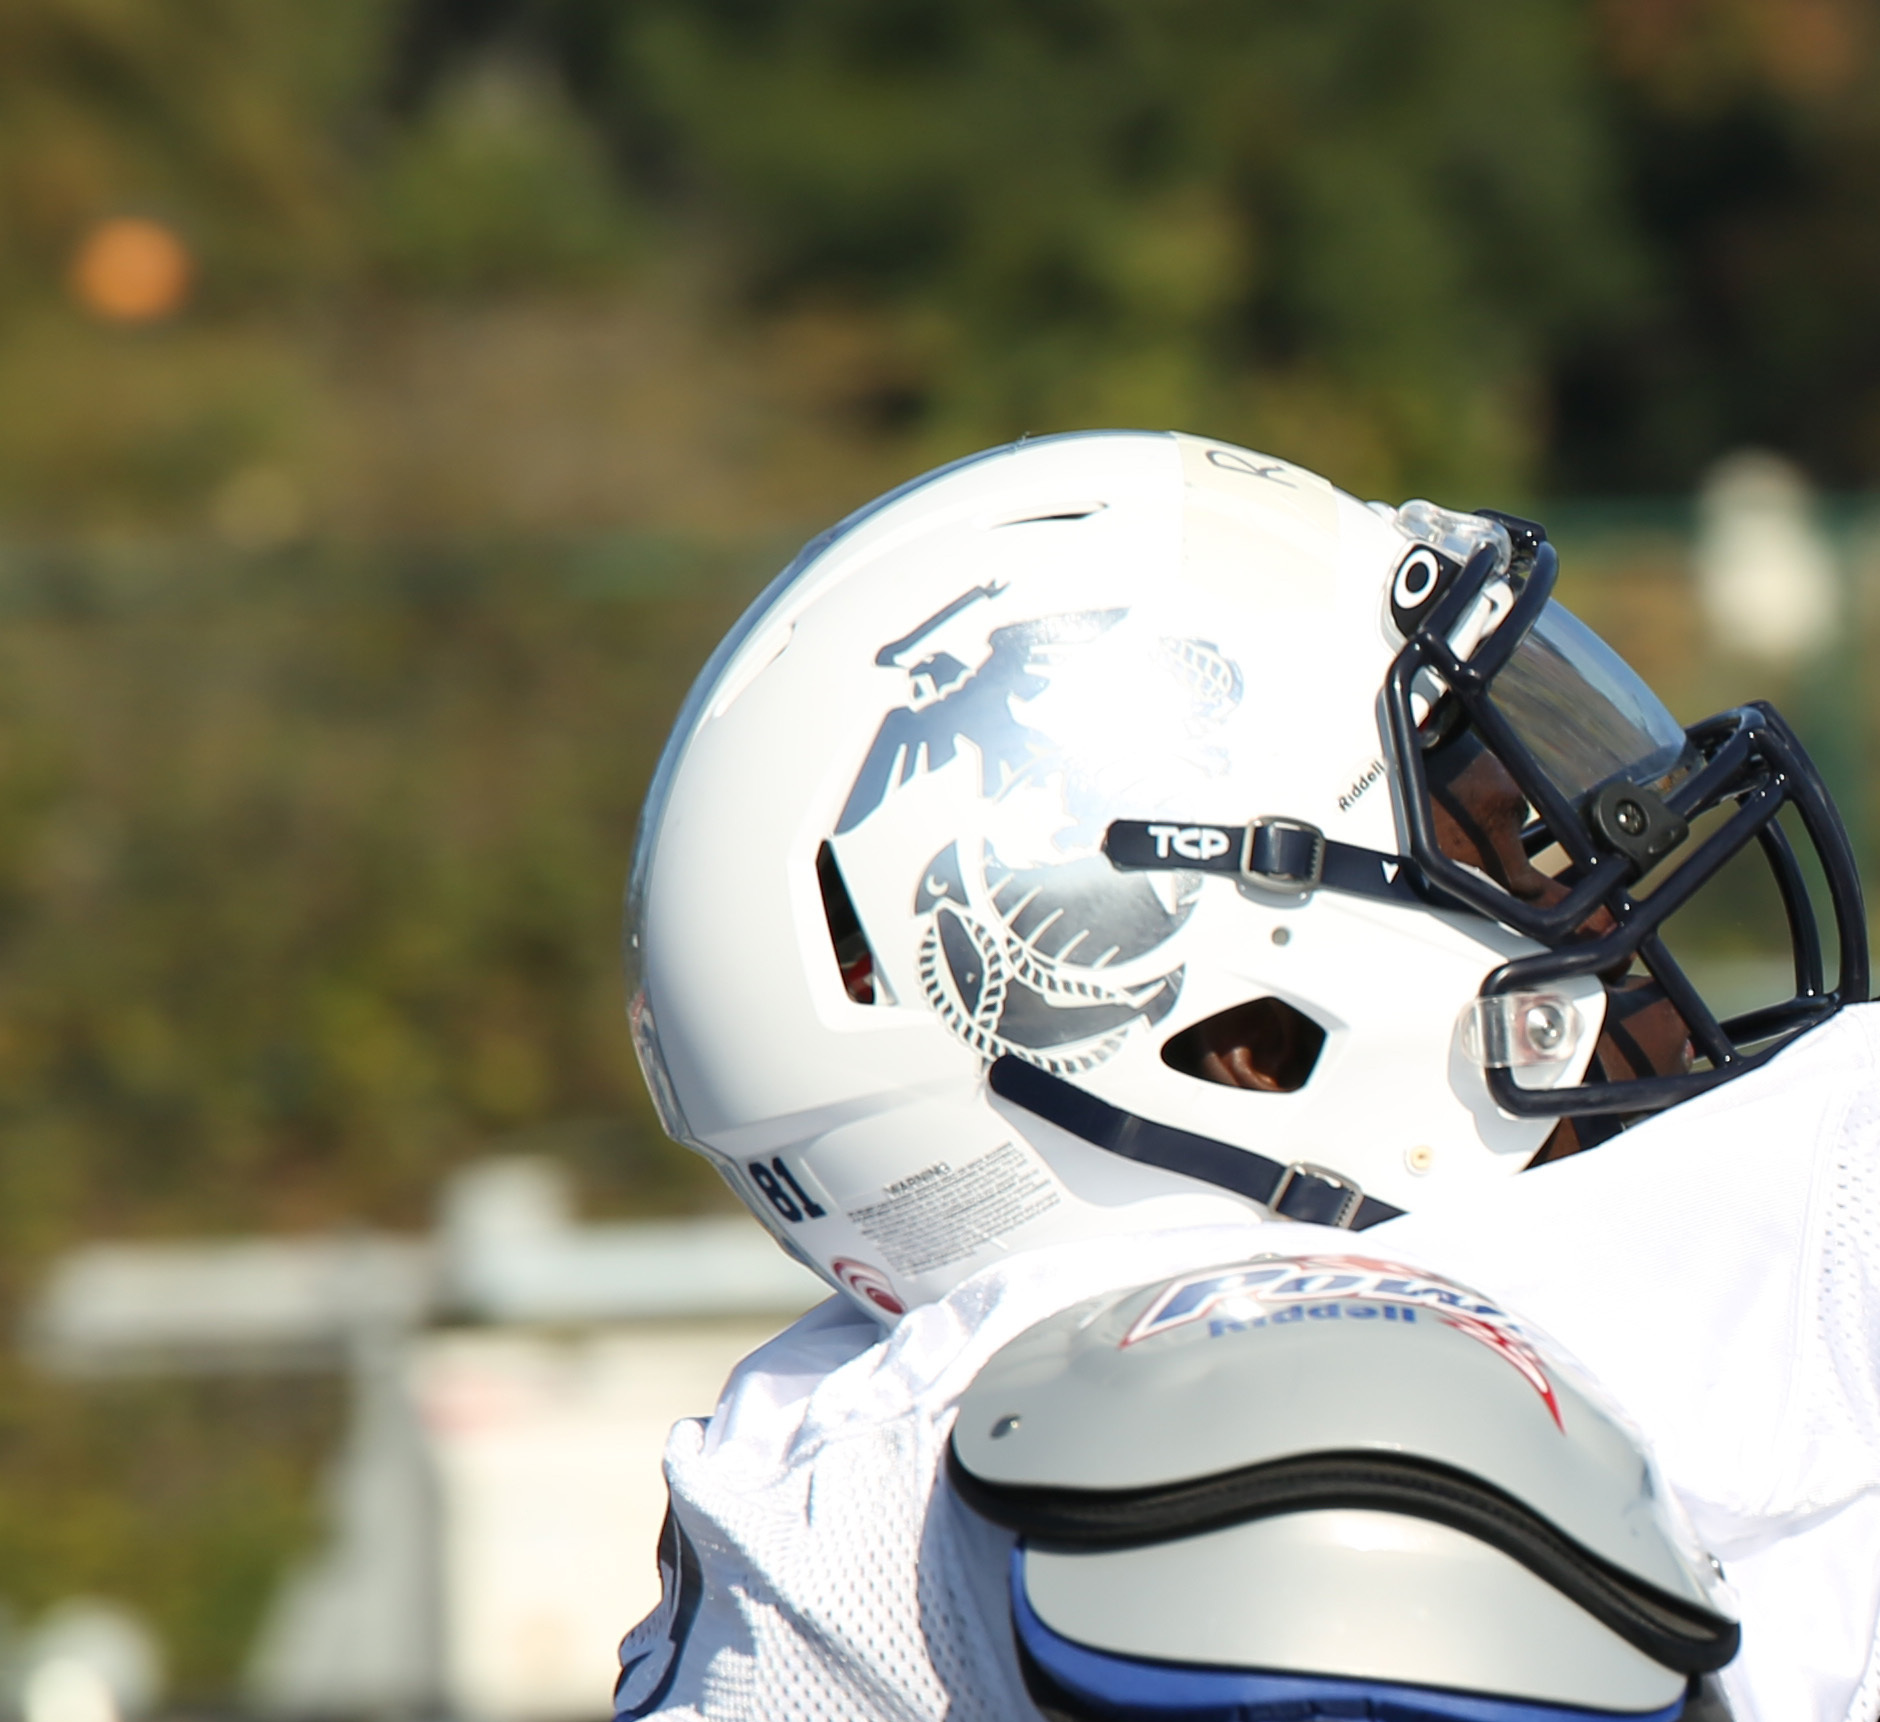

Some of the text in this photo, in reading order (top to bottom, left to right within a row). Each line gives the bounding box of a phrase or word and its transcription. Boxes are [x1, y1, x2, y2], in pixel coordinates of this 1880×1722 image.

[1338, 760, 1386, 812] Riddell
[1147, 825, 1231, 860] TCP
[748, 1157, 828, 1224] 81
[884, 1161, 952, 1196] WARNING
